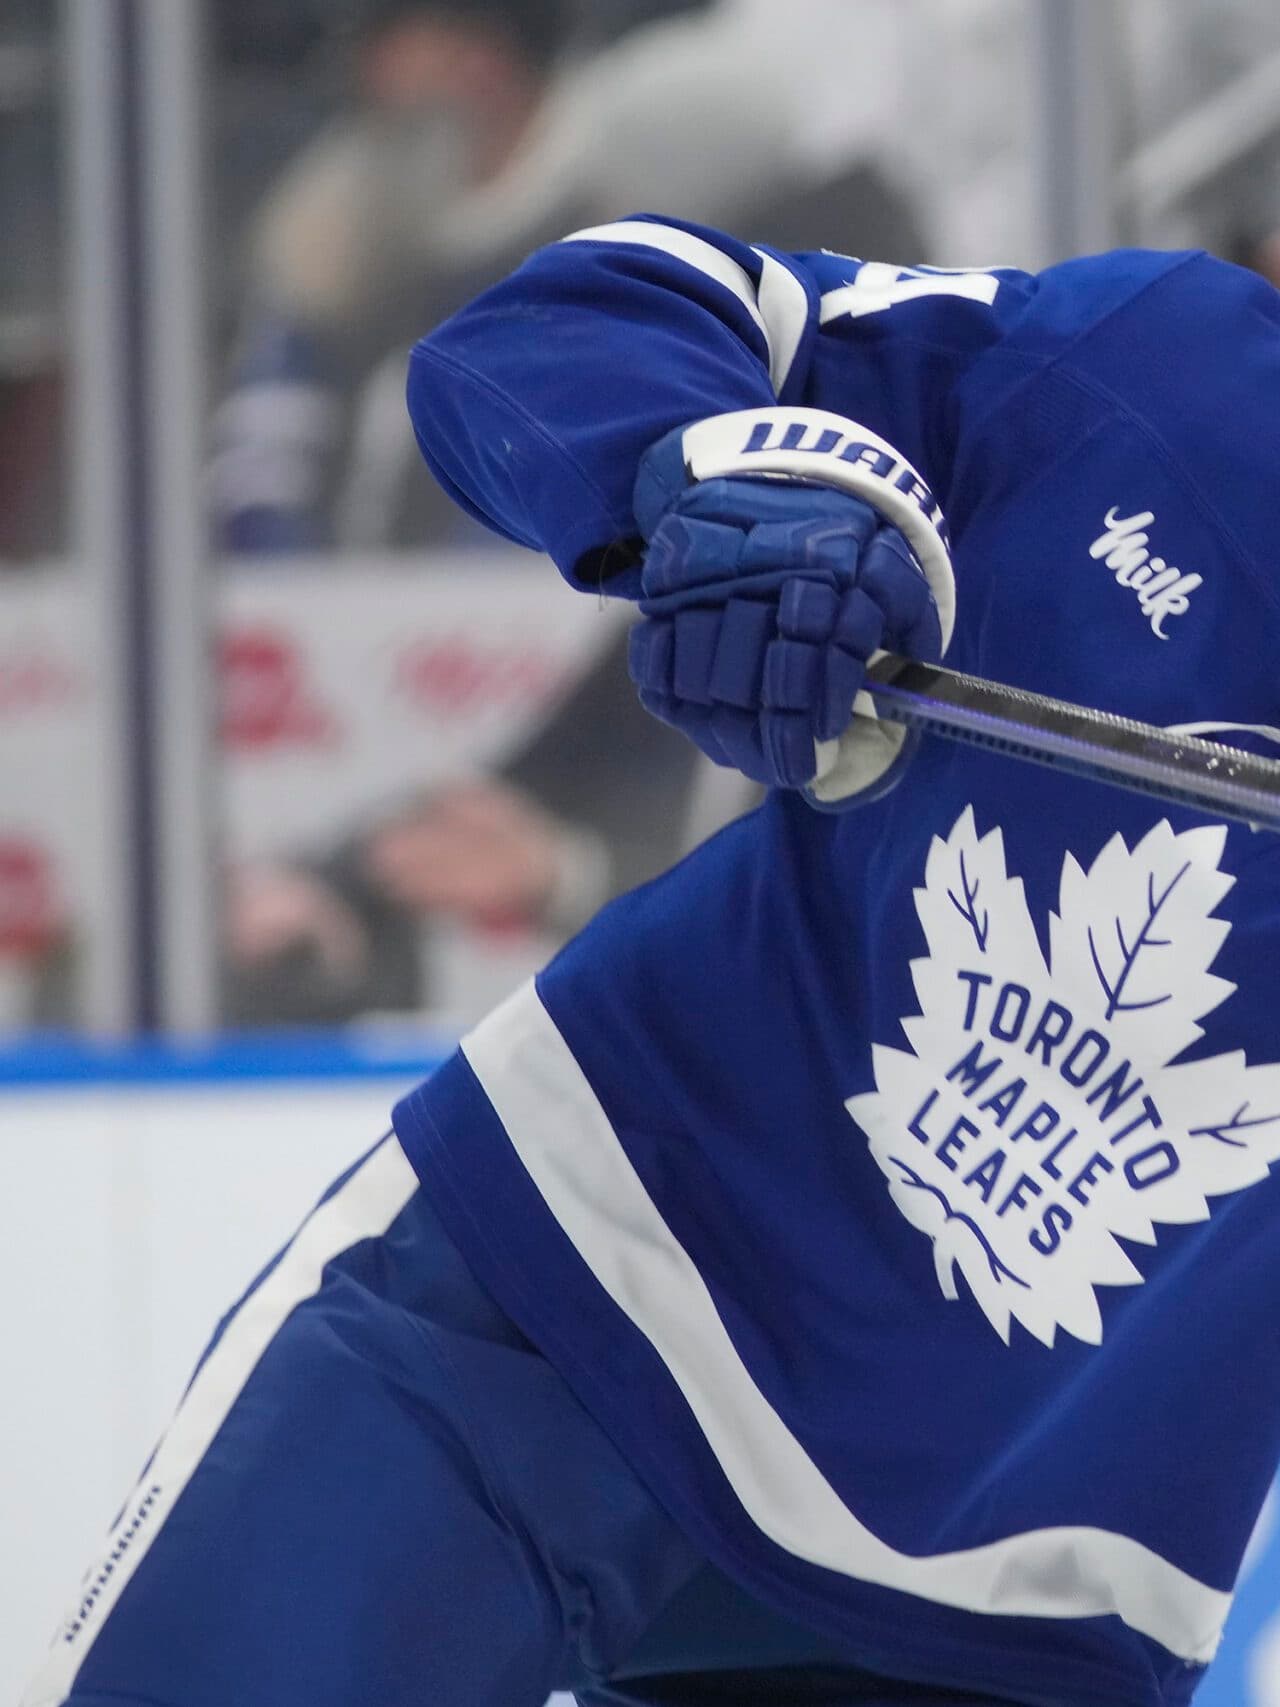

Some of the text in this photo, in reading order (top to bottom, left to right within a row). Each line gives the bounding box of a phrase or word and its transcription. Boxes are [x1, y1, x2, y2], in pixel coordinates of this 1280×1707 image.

[1089, 505, 1203, 640] Milk
[944, 1039, 1115, 1207] MAPLE
[957, 969, 1181, 1191] TORONTO
[906, 1088, 1073, 1257] LEAFS
